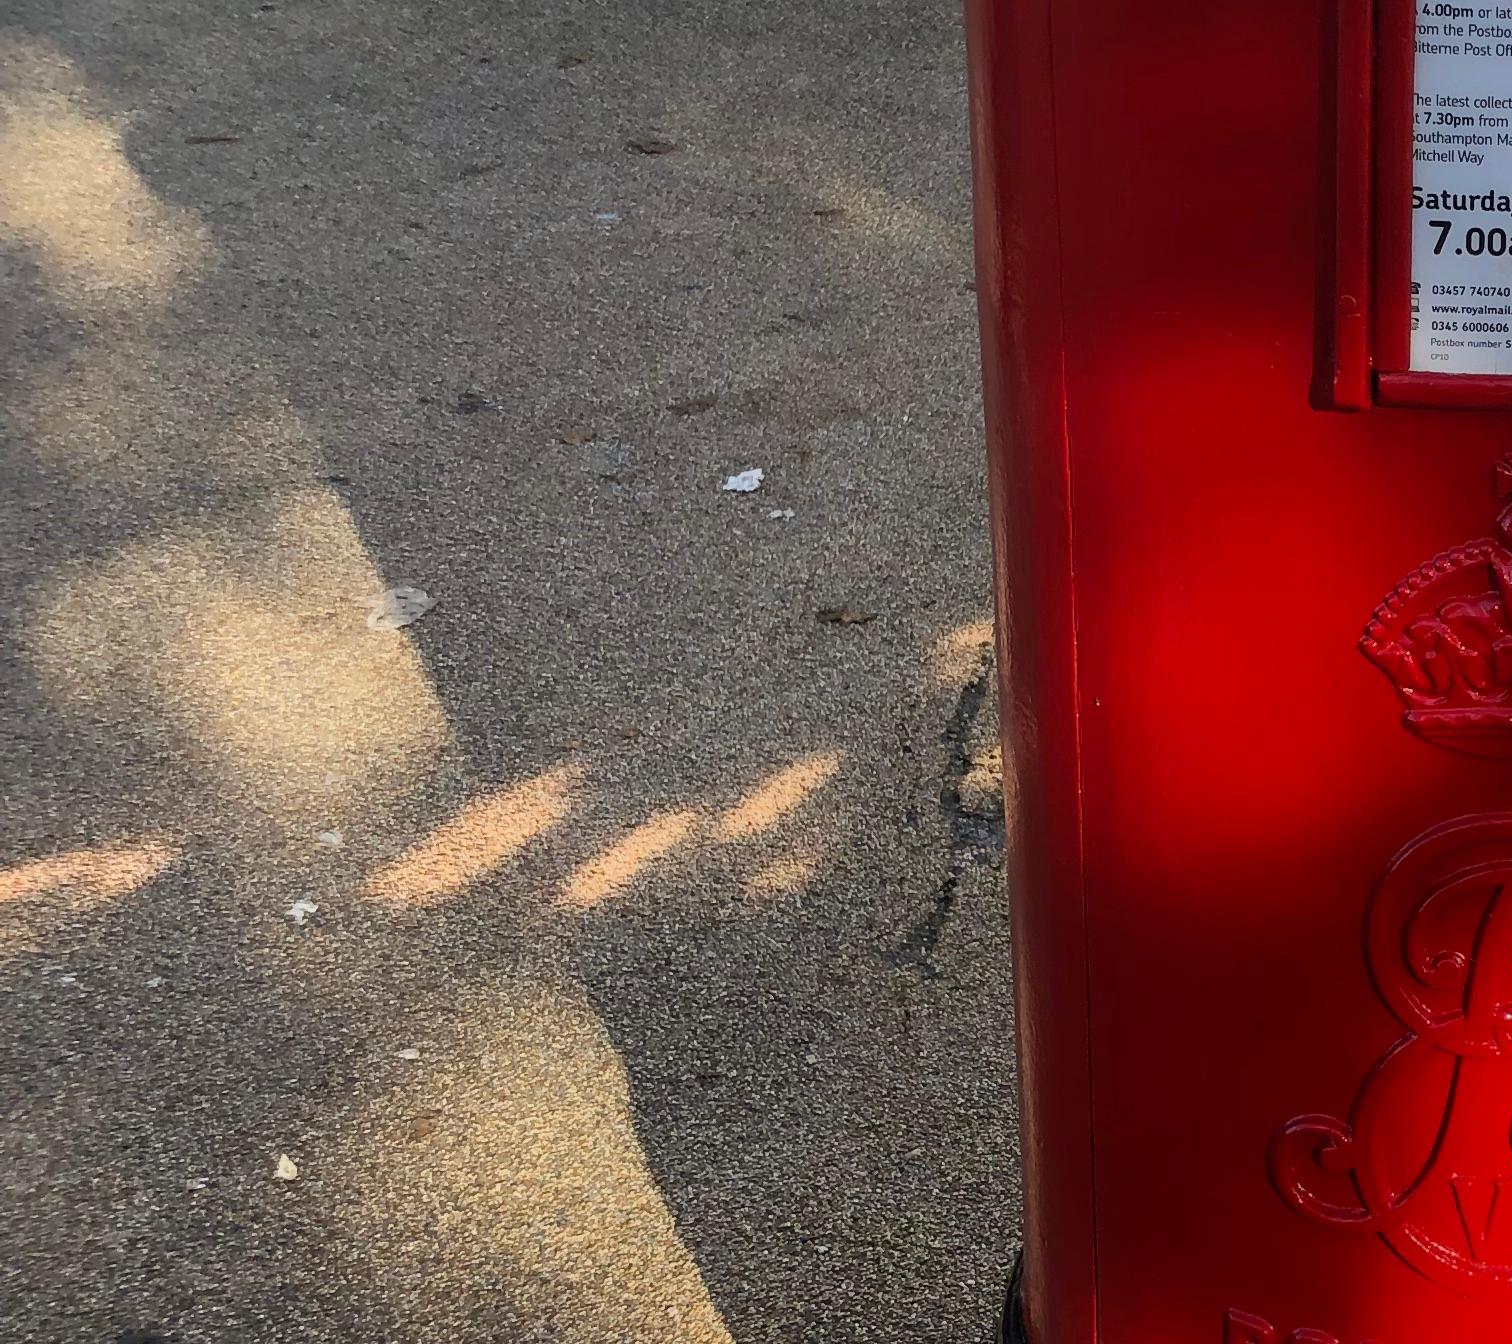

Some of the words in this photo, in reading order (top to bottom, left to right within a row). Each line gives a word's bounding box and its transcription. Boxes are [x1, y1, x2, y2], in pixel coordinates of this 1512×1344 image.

[1422, 3, 1474, 20] 4.00pm
[1478, 8, 1492, 19] or
[1415, 25, 1439, 36] rom
[1443, 24, 1464, 36] the
[1464, 42, 1492, 56] Post
[1436, 94, 1470, 108] latest
[1424, 112, 1475, 128] 7.30pm
[1479, 114, 1509, 127] from
[1458, 149, 1485, 166] Way
[1432, 285, 1466, 296] 03457
[1470, 286, 1511, 297] 740740
[1431, 320, 1458, 331] 0345
[1462, 322, 1510, 333] 6000606
[1430, 338, 1464, 347] Postbox
[1467, 338, 1502, 348] number
